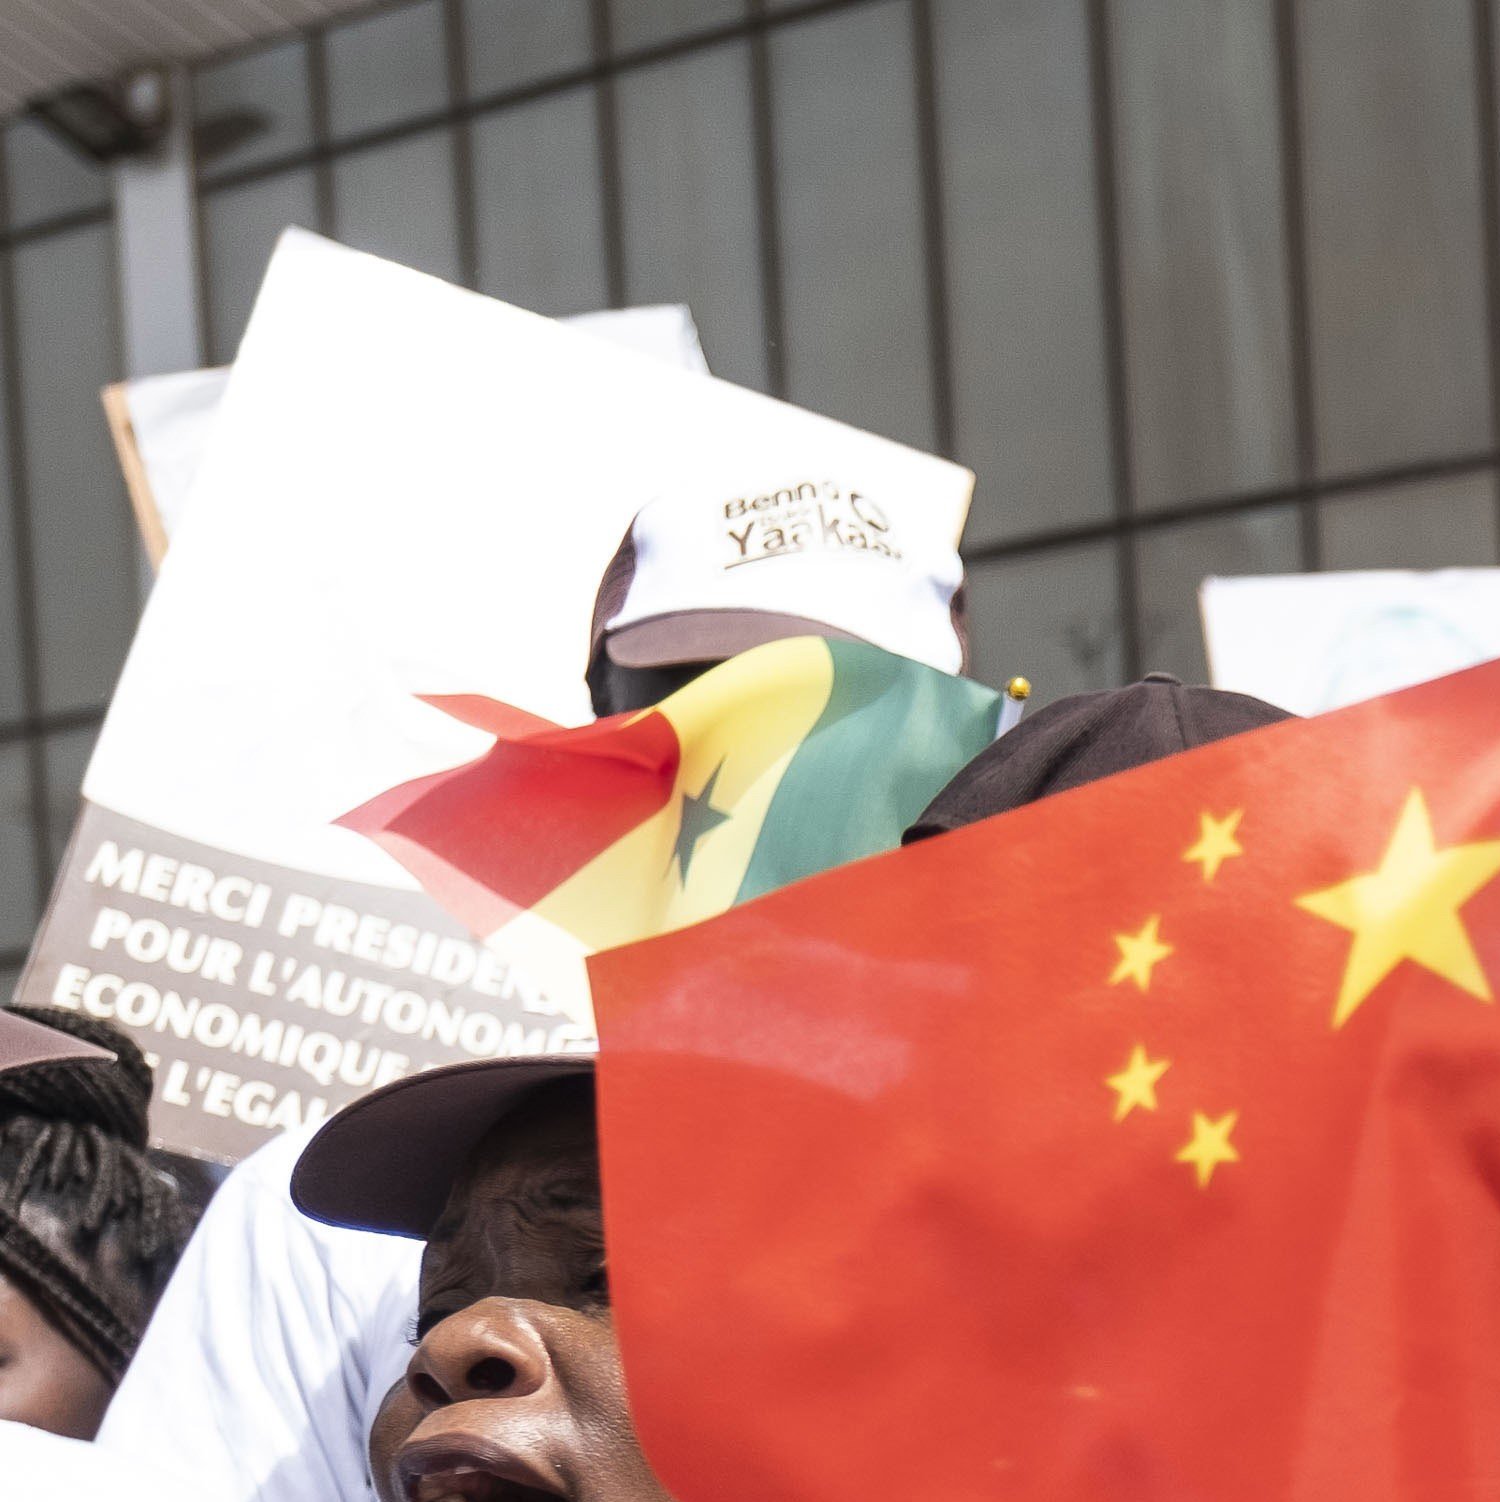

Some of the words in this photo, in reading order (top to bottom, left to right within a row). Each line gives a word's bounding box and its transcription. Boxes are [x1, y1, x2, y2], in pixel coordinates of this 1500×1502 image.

[85, 840, 273, 929] MERCI
[277, 891, 563, 1017] PRESIDEN
[88, 906, 239, 986] POUR
[248, 951, 598, 1057] L'AUTONOMI
[51, 963, 410, 1088] ECONOMIQUE
[161, 1058, 347, 1131] L'EGAL
